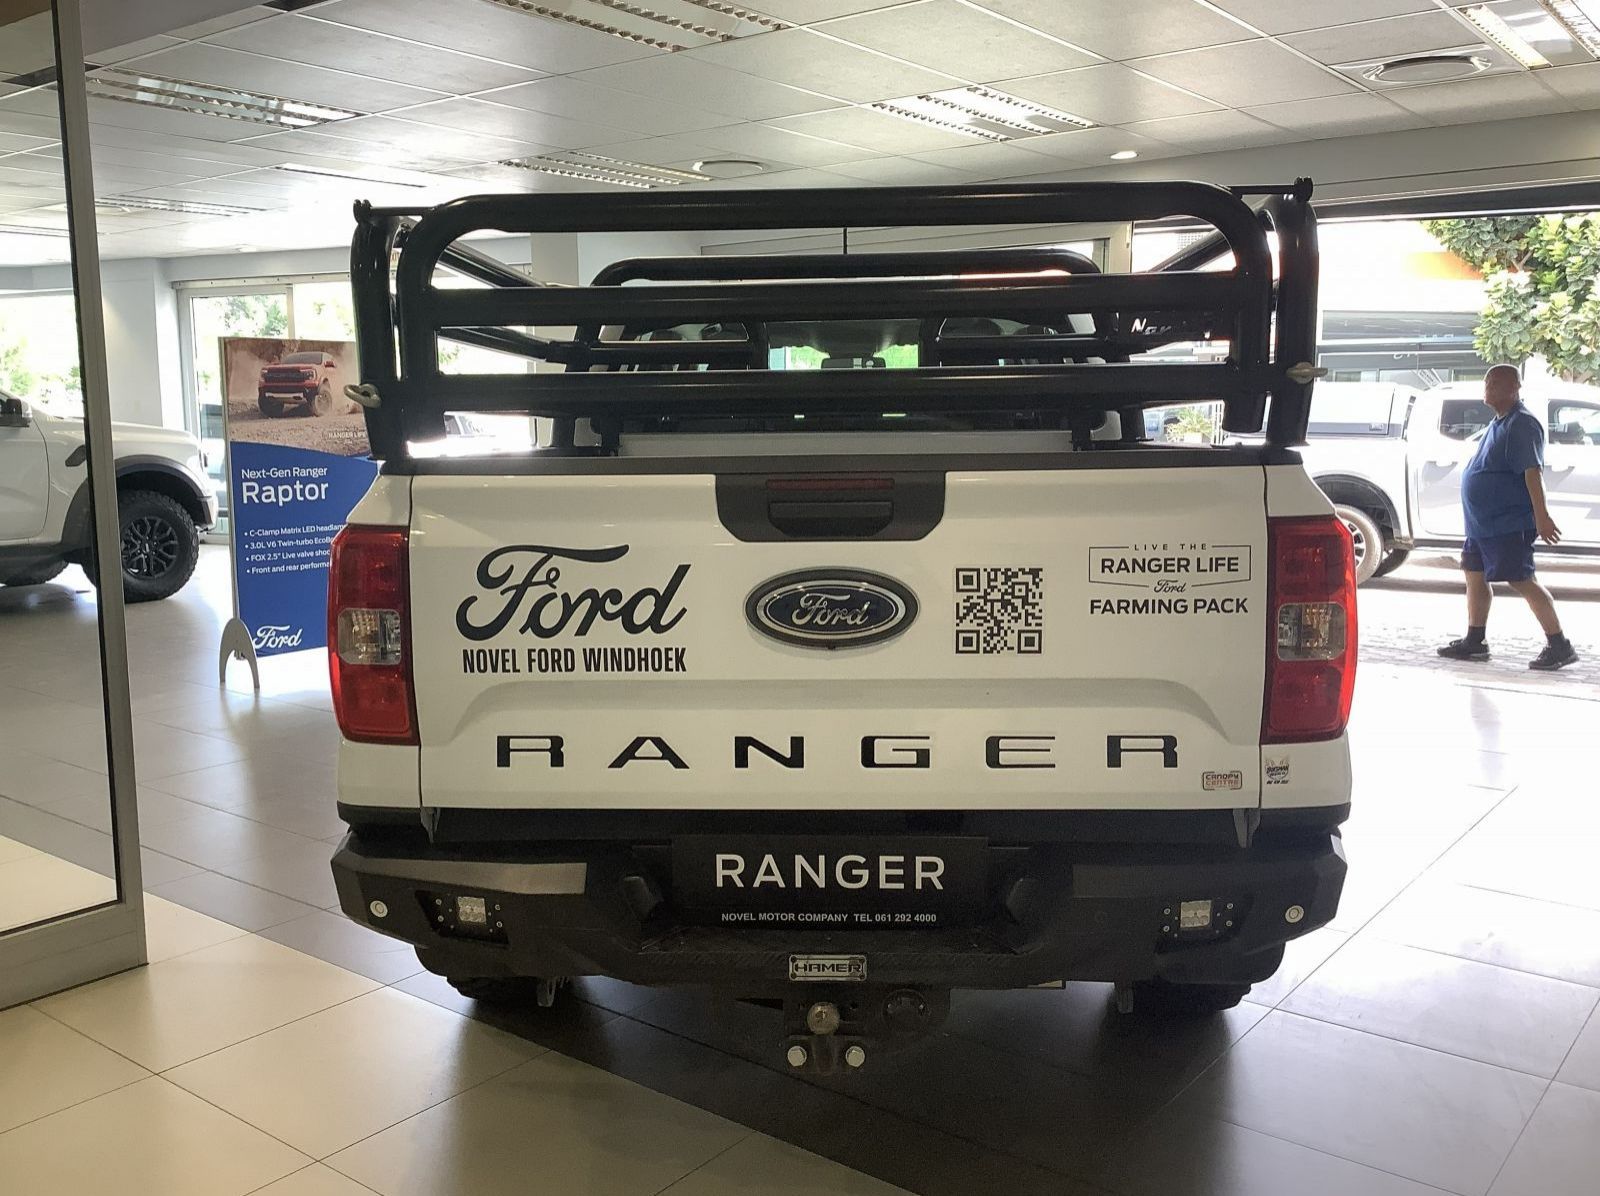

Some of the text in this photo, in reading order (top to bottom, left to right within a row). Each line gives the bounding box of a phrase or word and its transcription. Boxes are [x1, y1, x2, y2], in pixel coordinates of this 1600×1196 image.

[241, 467, 328, 479] Next-Gen Ranger
[242, 480, 329, 507] Raptor
[249, 523, 345, 538] C-Clamp Matrix LED headlam
[250, 541, 266, 550] 3.0L
[266, 540, 277, 548] V6
[278, 537, 314, 548] Twin-turbo
[1134, 543, 1168, 551] LIVE
[250, 553, 266, 562] FOX
[282, 550, 296, 559] Live
[296, 550, 314, 558] valve
[251, 566, 271, 574] Front
[271, 564, 285, 573] and
[286, 563, 299, 571] rear
[1101, 556, 1239, 574] RANGER LIFE
[456, 544, 691, 641] Ford
[1153, 579, 1187, 593] Ford
[791, 592, 871, 626] Ford
[1090, 597, 1249, 614] FARMING PACK
[252, 625, 302, 649] Ford
[462, 647, 687, 673] NOVEL FORD WINDHOEK
[496, 735, 1178, 769] RANGER
[715, 853, 945, 890] RANGER
[721, 912, 937, 922] NOVEL MOTOR COMPANY TEL 061 292 4000
[794, 963, 863, 973] HAMER
